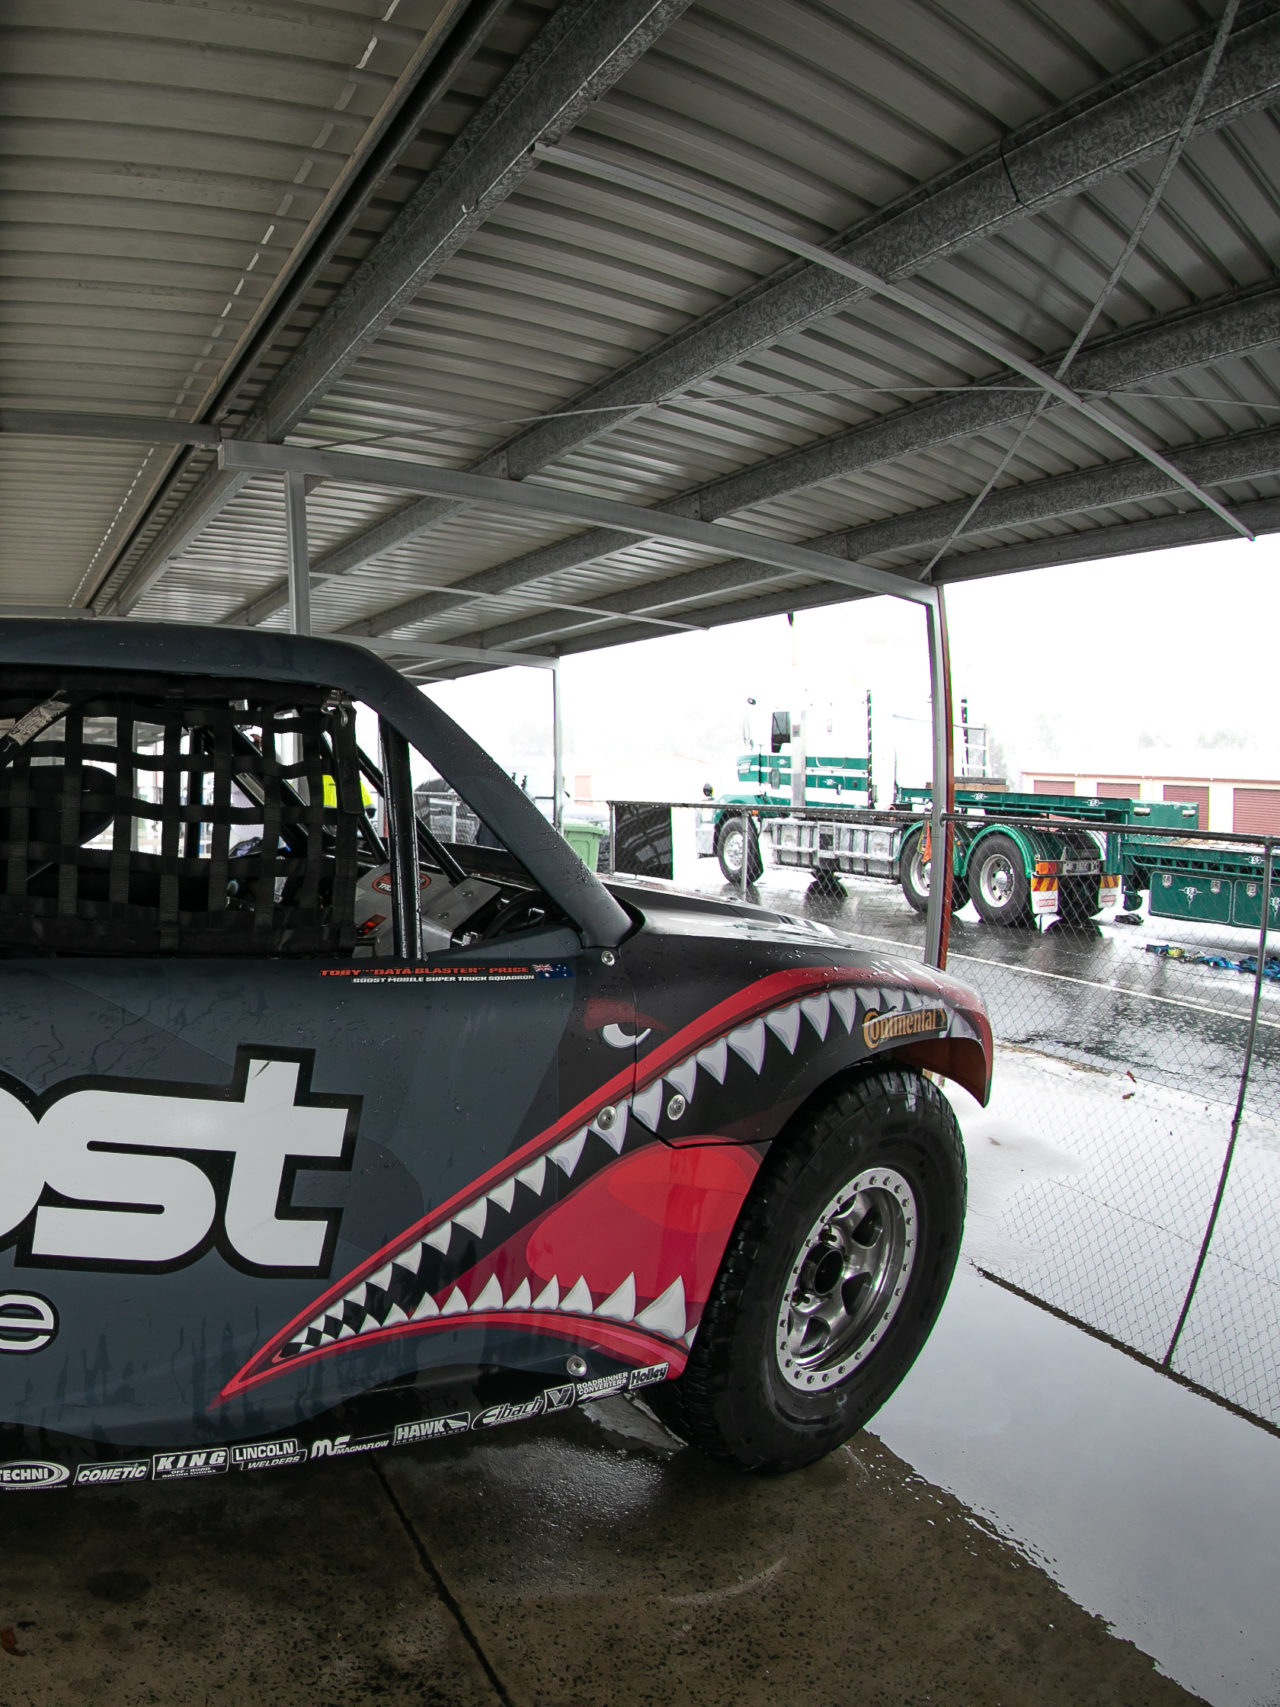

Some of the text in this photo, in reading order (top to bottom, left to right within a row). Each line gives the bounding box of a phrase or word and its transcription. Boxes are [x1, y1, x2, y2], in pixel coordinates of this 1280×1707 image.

[488, 966, 530, 974] PRICE
[863, 1008, 938, 1049] Continental
[576, 1371, 629, 1391] ROADRUNNER
[631, 1366, 668, 1385] Holley
[578, 1377, 628, 1396] CONVERTERS
[482, 1395, 544, 1424] Eibach
[397, 1419, 446, 1441] HAWK
[235, 1442, 294, 1461] LINCOLN
[335, 1439, 389, 1455] MAGNAFLOW
[156, 1451, 227, 1470] KING
[247, 1455, 301, 1469] WELDERS
[77, 1465, 147, 1482] COMETIC
